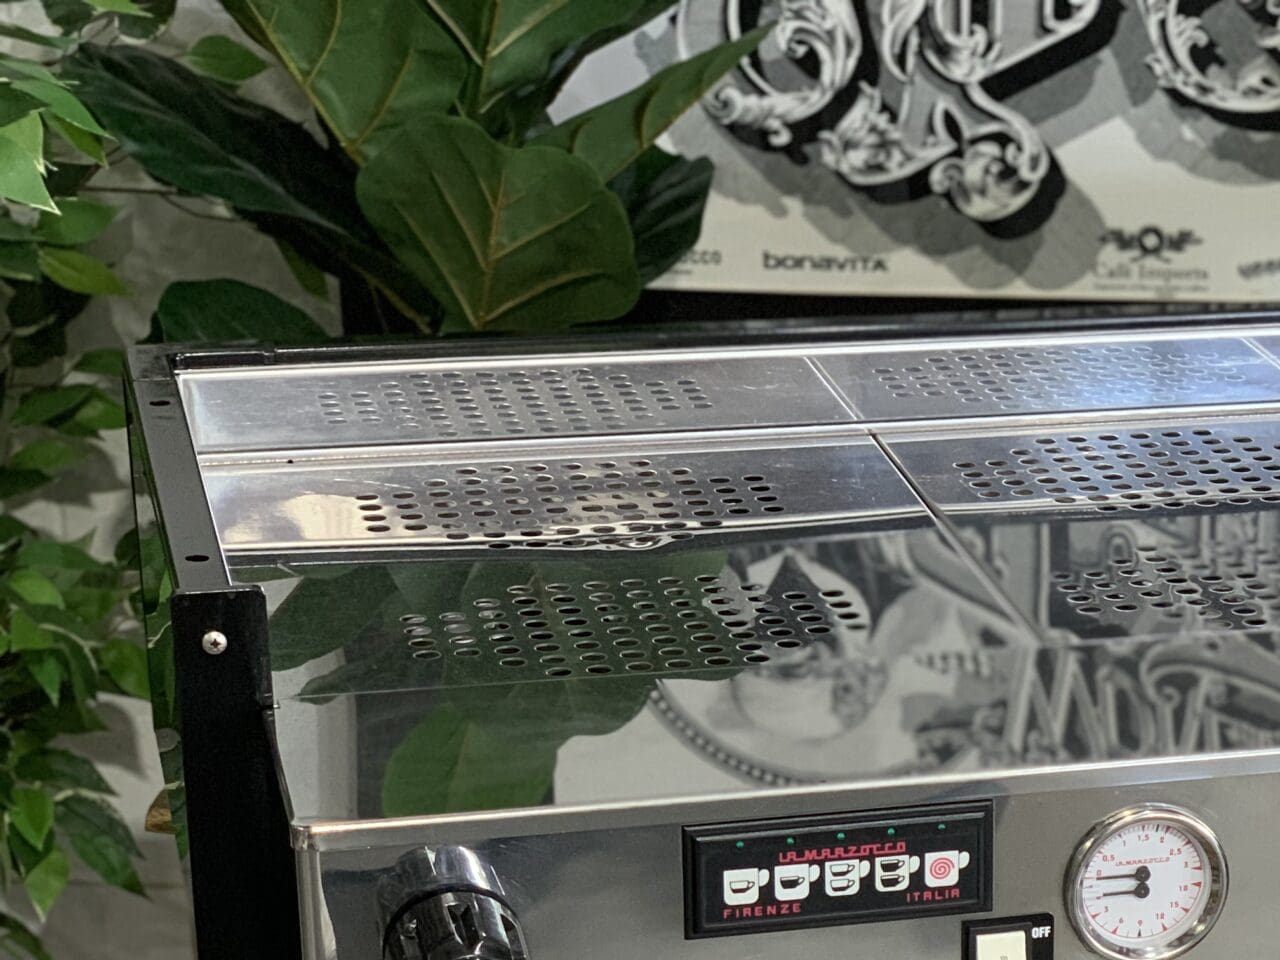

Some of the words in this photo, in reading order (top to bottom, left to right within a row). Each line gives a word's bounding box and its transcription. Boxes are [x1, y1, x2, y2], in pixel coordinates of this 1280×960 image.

[723, 902, 802, 920] FIRENZE
[906, 888, 961, 903] ITALIA
[1031, 926, 1052, 939] OFF
